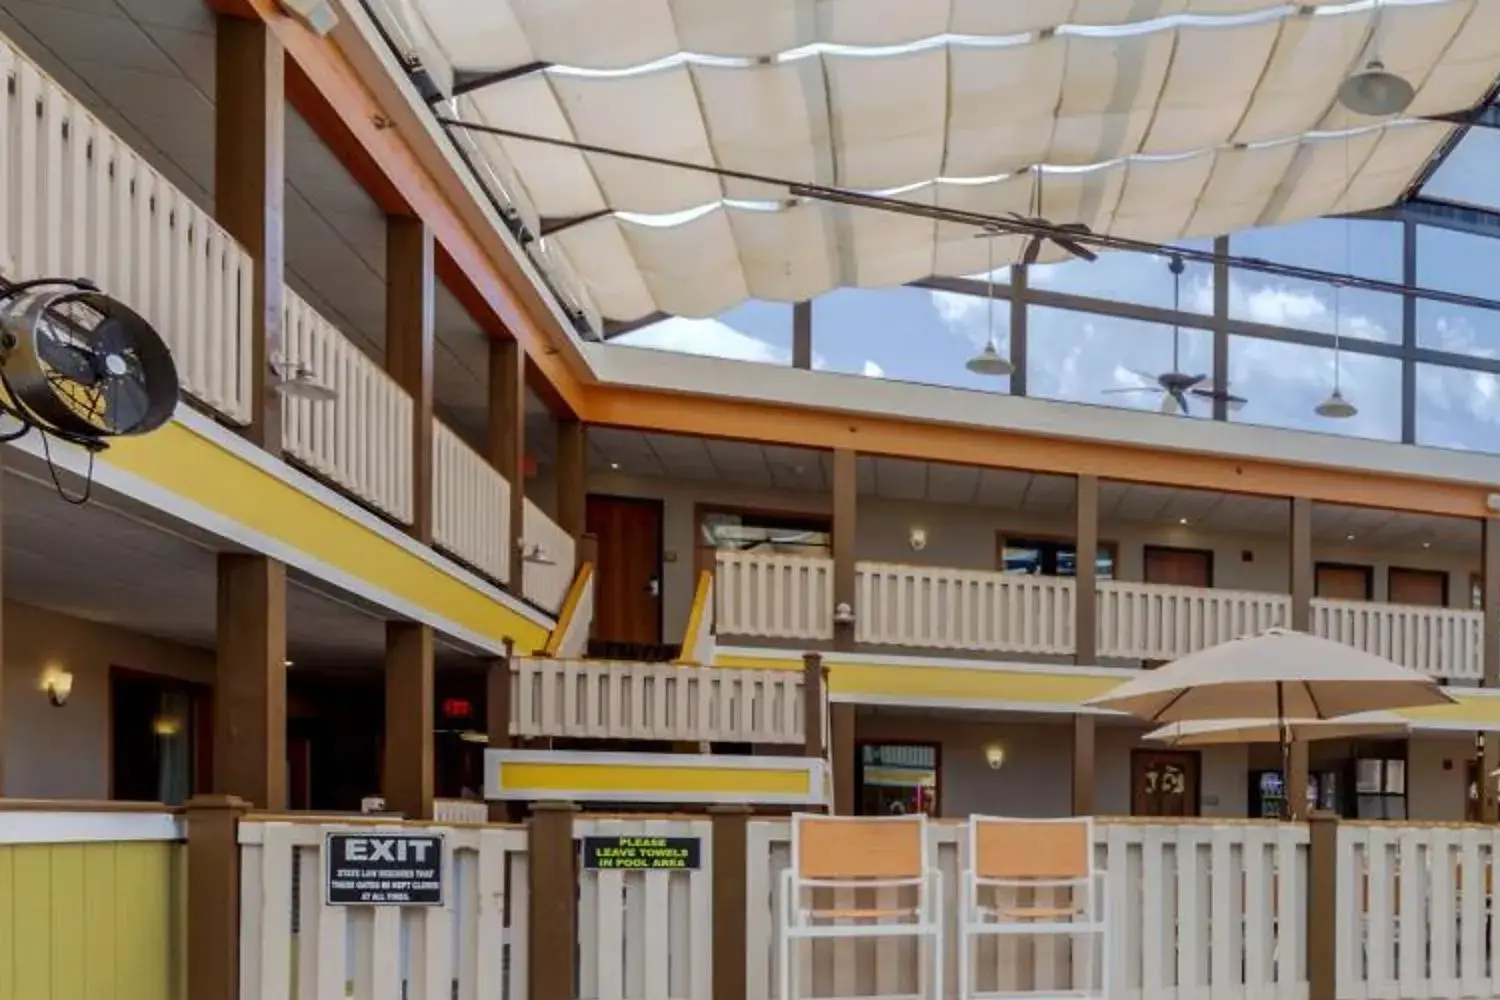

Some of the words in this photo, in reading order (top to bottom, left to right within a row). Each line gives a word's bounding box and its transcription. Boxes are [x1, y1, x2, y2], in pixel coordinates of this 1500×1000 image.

[620, 837, 667, 847] PLEASE
[344, 838, 433, 862] EXIT
[596, 848, 636, 857] LEAVE
[640, 848, 689, 857] TOWELS
[599, 858, 613, 867] IN
[616, 858, 649, 867] POOL
[653, 858, 685, 867] AREA
